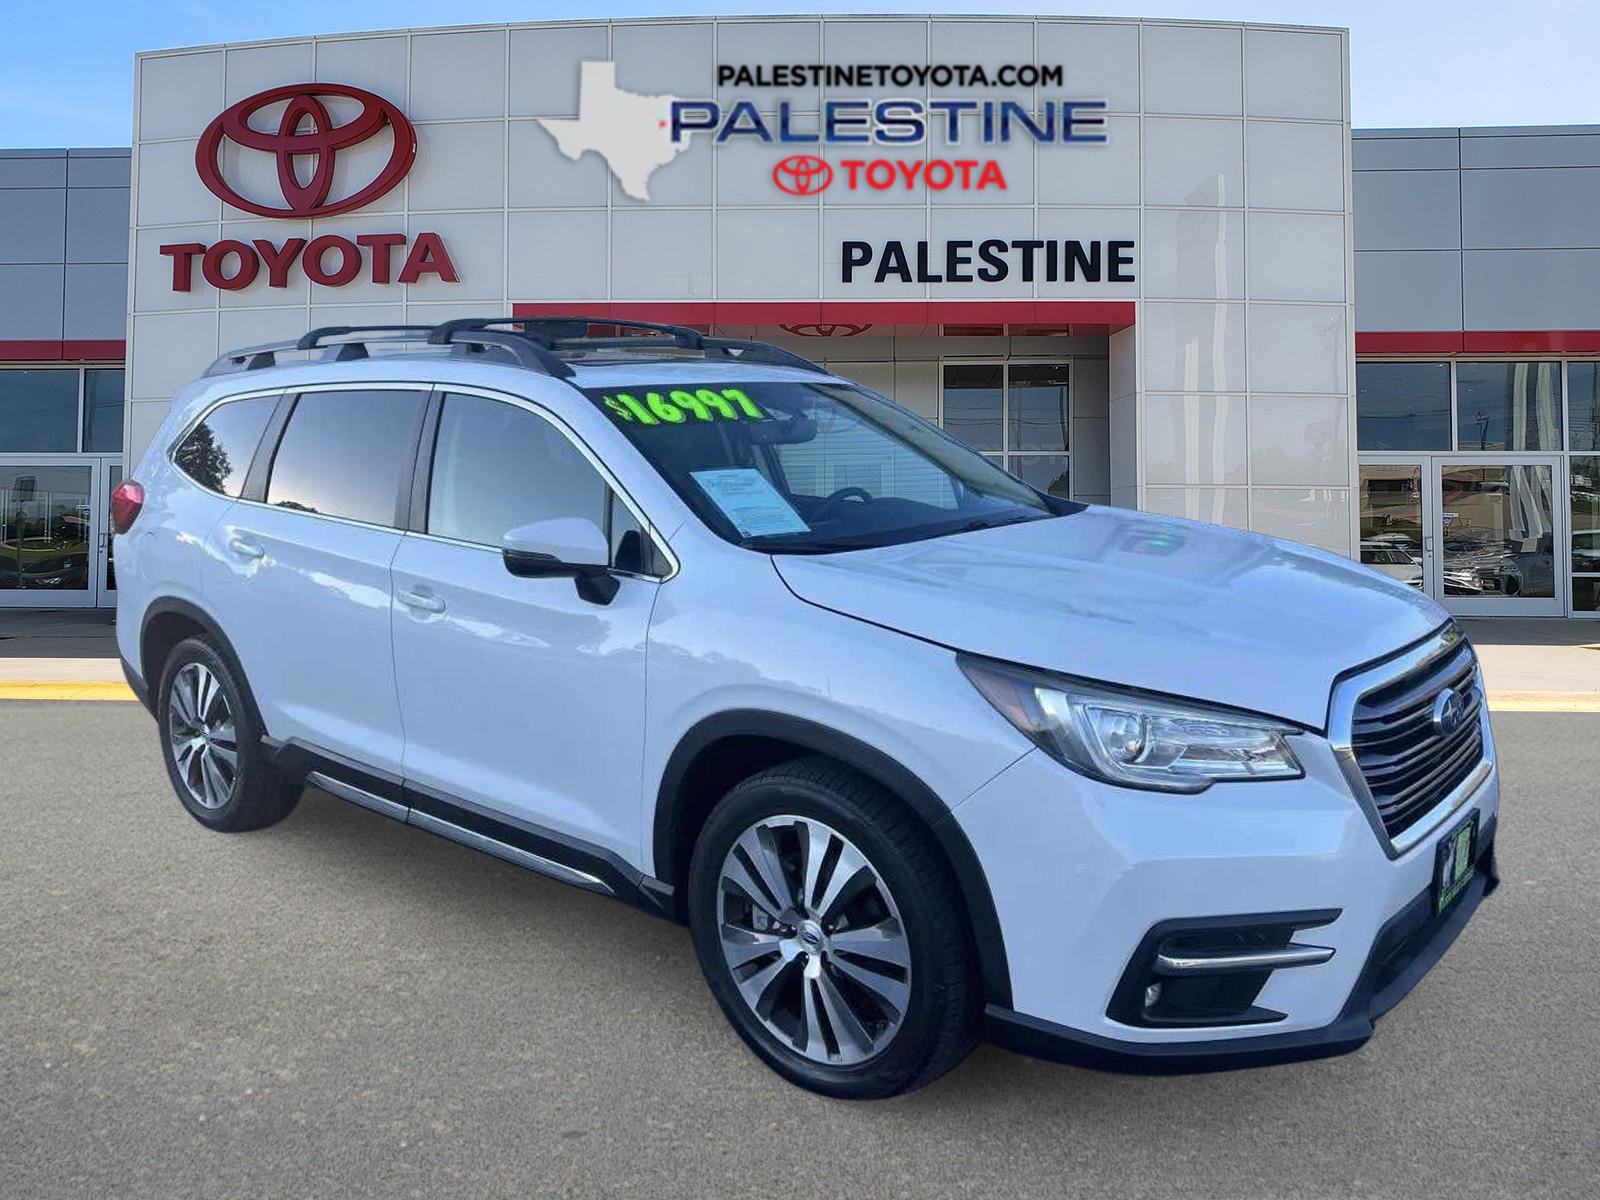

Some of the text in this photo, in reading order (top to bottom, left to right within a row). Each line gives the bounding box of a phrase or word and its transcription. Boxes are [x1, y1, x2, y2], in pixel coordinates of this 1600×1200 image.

[159, 232, 460, 292] TOYOTA
[841, 239, 1136, 283] PALESTINE
[603, 388, 765, 425] $16997
